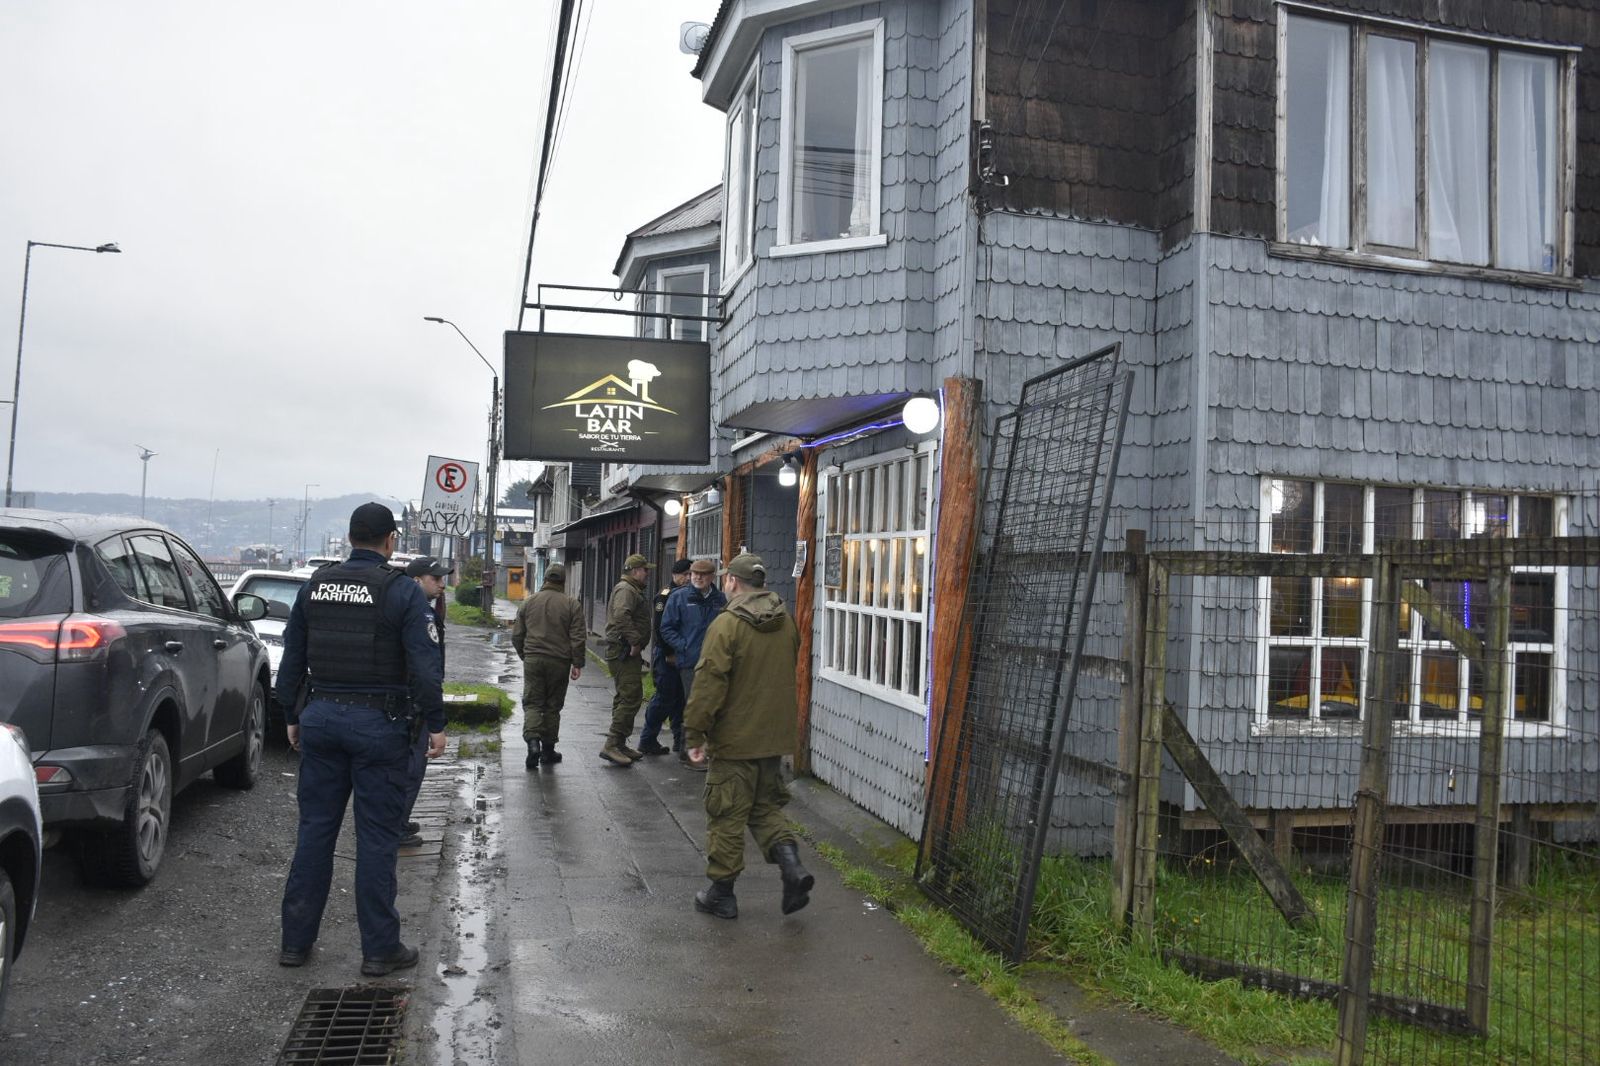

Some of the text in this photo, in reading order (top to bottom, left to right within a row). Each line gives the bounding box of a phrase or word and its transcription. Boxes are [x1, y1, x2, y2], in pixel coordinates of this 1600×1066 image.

[575, 403, 644, 420] LATIN
[587, 418, 632, 433] BAR
[318, 583, 369, 595] POLICIA
[310, 591, 374, 604] MARITIMA
